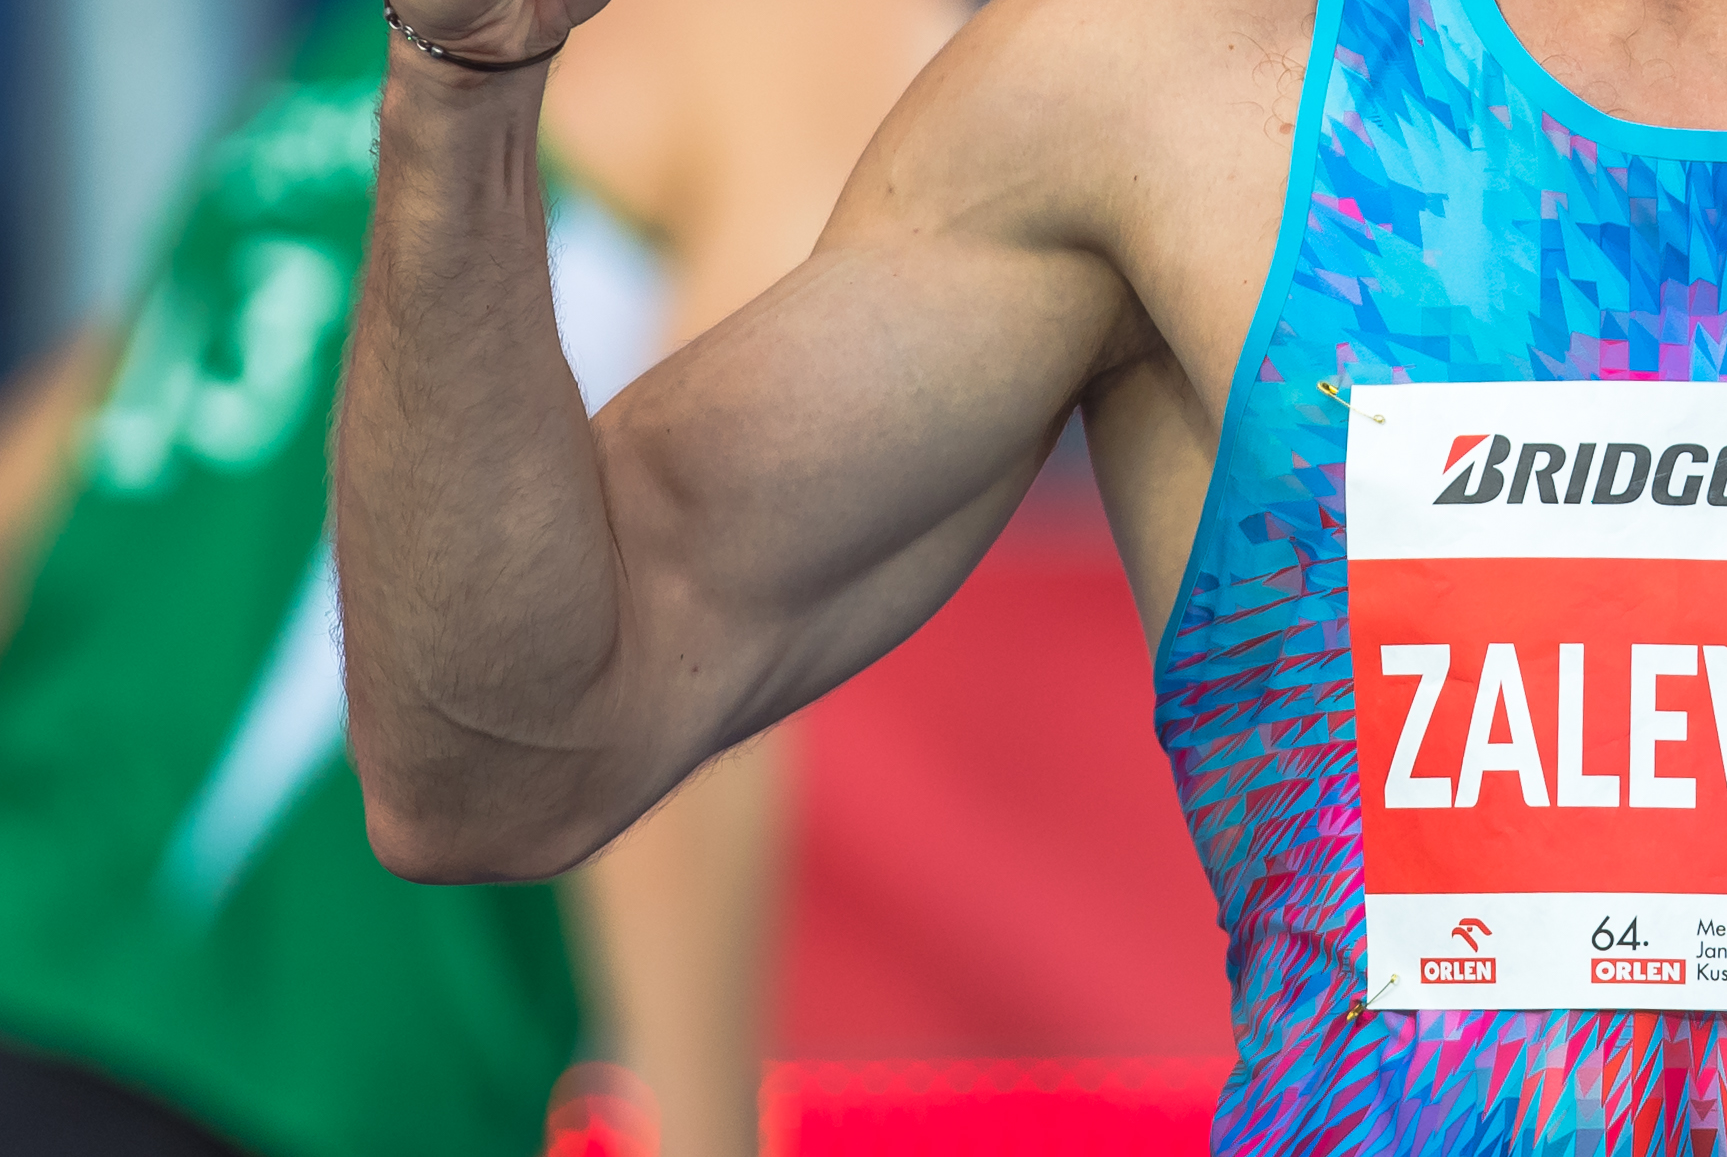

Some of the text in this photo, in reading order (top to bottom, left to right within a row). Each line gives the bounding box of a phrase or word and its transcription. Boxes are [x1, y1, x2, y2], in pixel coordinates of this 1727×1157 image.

[1591, 915, 1650, 952] 64.
[1423, 960, 1493, 981] ORLEN
[1594, 960, 1682, 982] ORLEN
